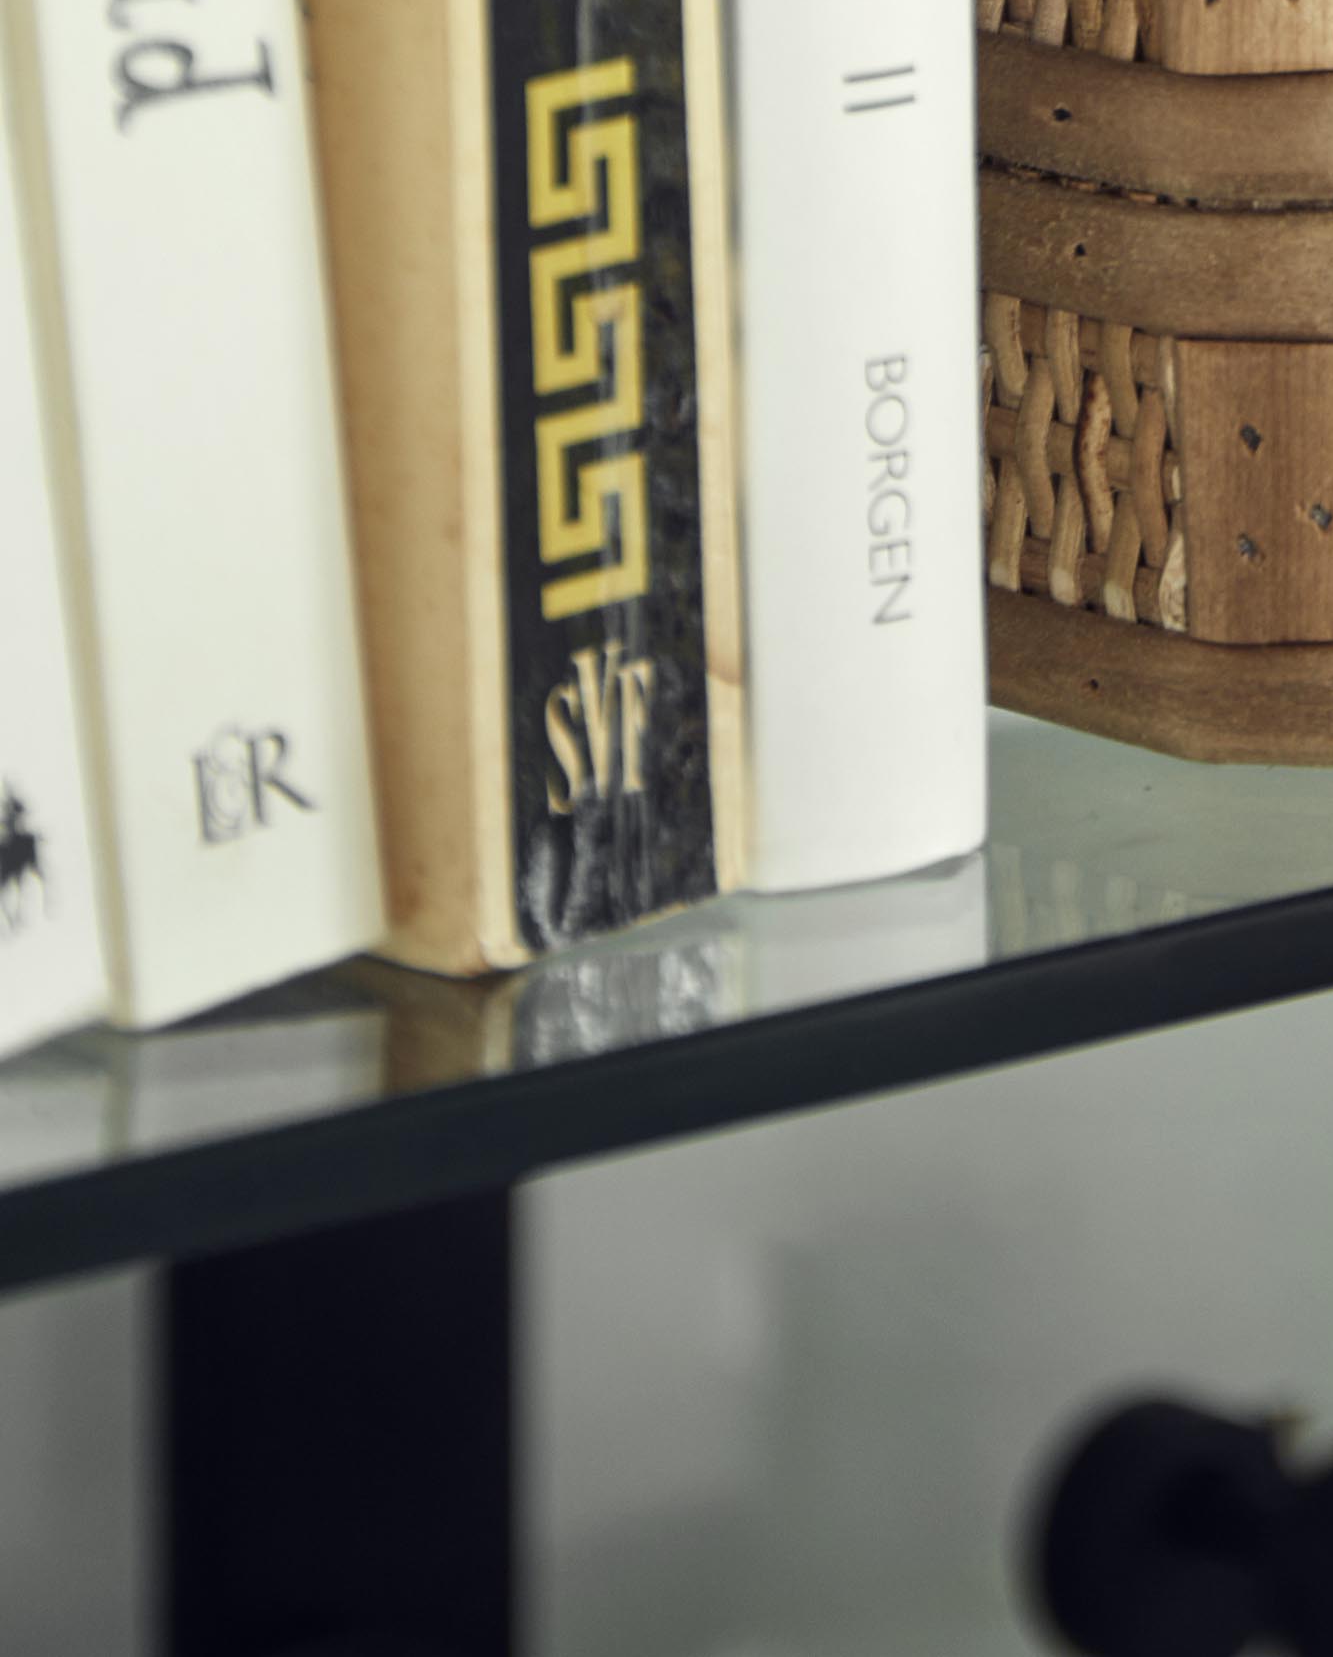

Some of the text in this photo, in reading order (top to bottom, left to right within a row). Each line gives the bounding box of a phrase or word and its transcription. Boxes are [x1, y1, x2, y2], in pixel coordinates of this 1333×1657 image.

[842, 62, 917, 116] II
[863, 352, 914, 628] BORGEN
[543, 637, 654, 817] SVF
